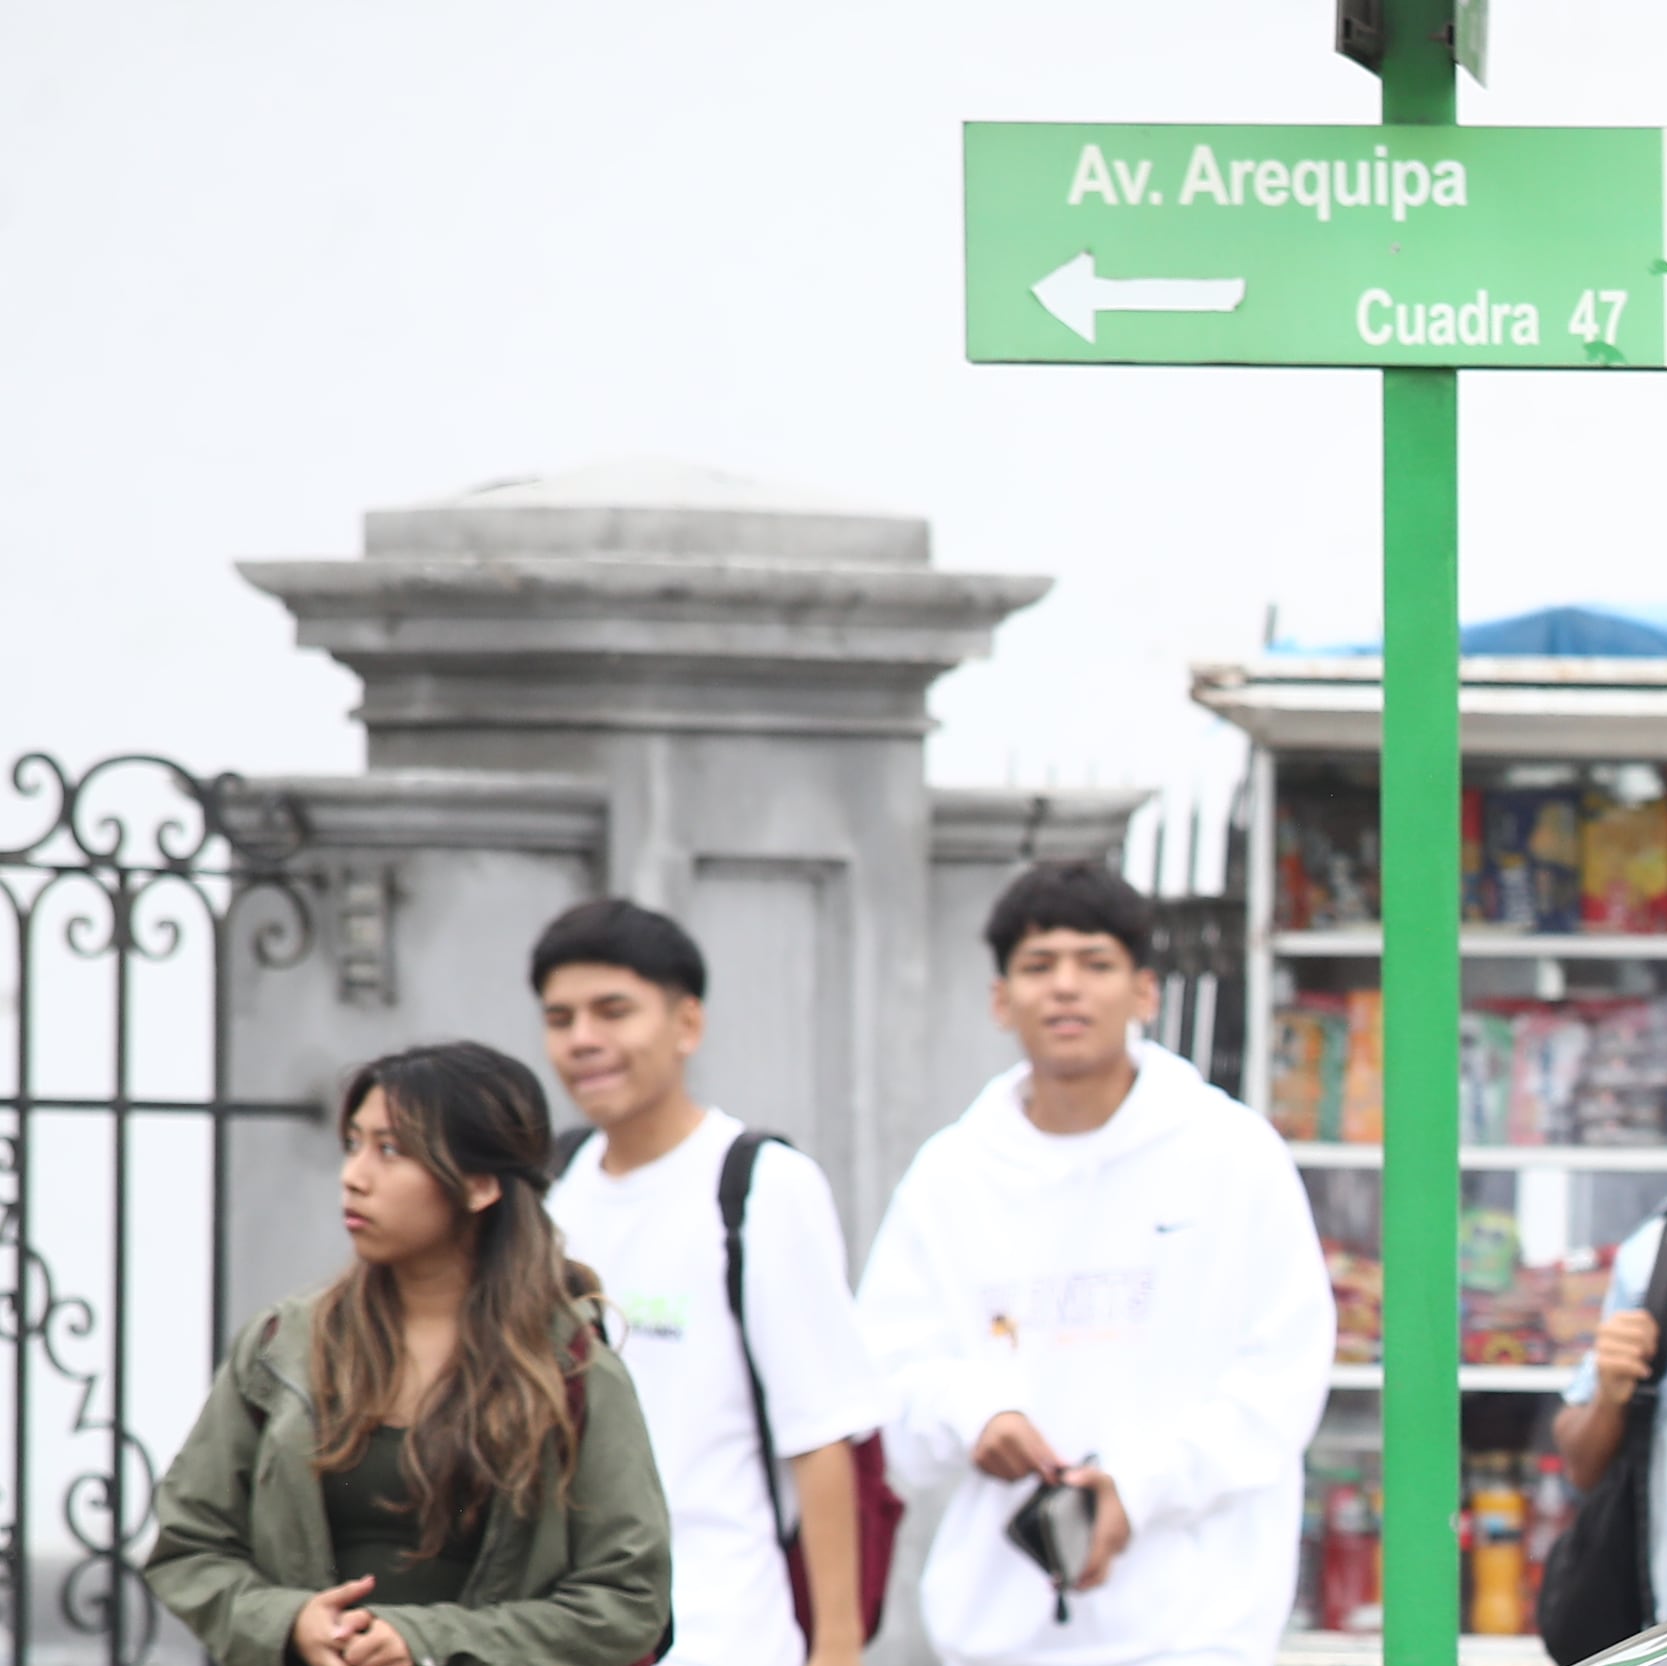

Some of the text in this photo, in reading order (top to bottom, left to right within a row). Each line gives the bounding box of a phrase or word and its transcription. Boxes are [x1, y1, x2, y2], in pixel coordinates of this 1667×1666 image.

[1068, 144, 1467, 221] Av. Arequipa
[1356, 288, 1628, 346] Cuadra 47
